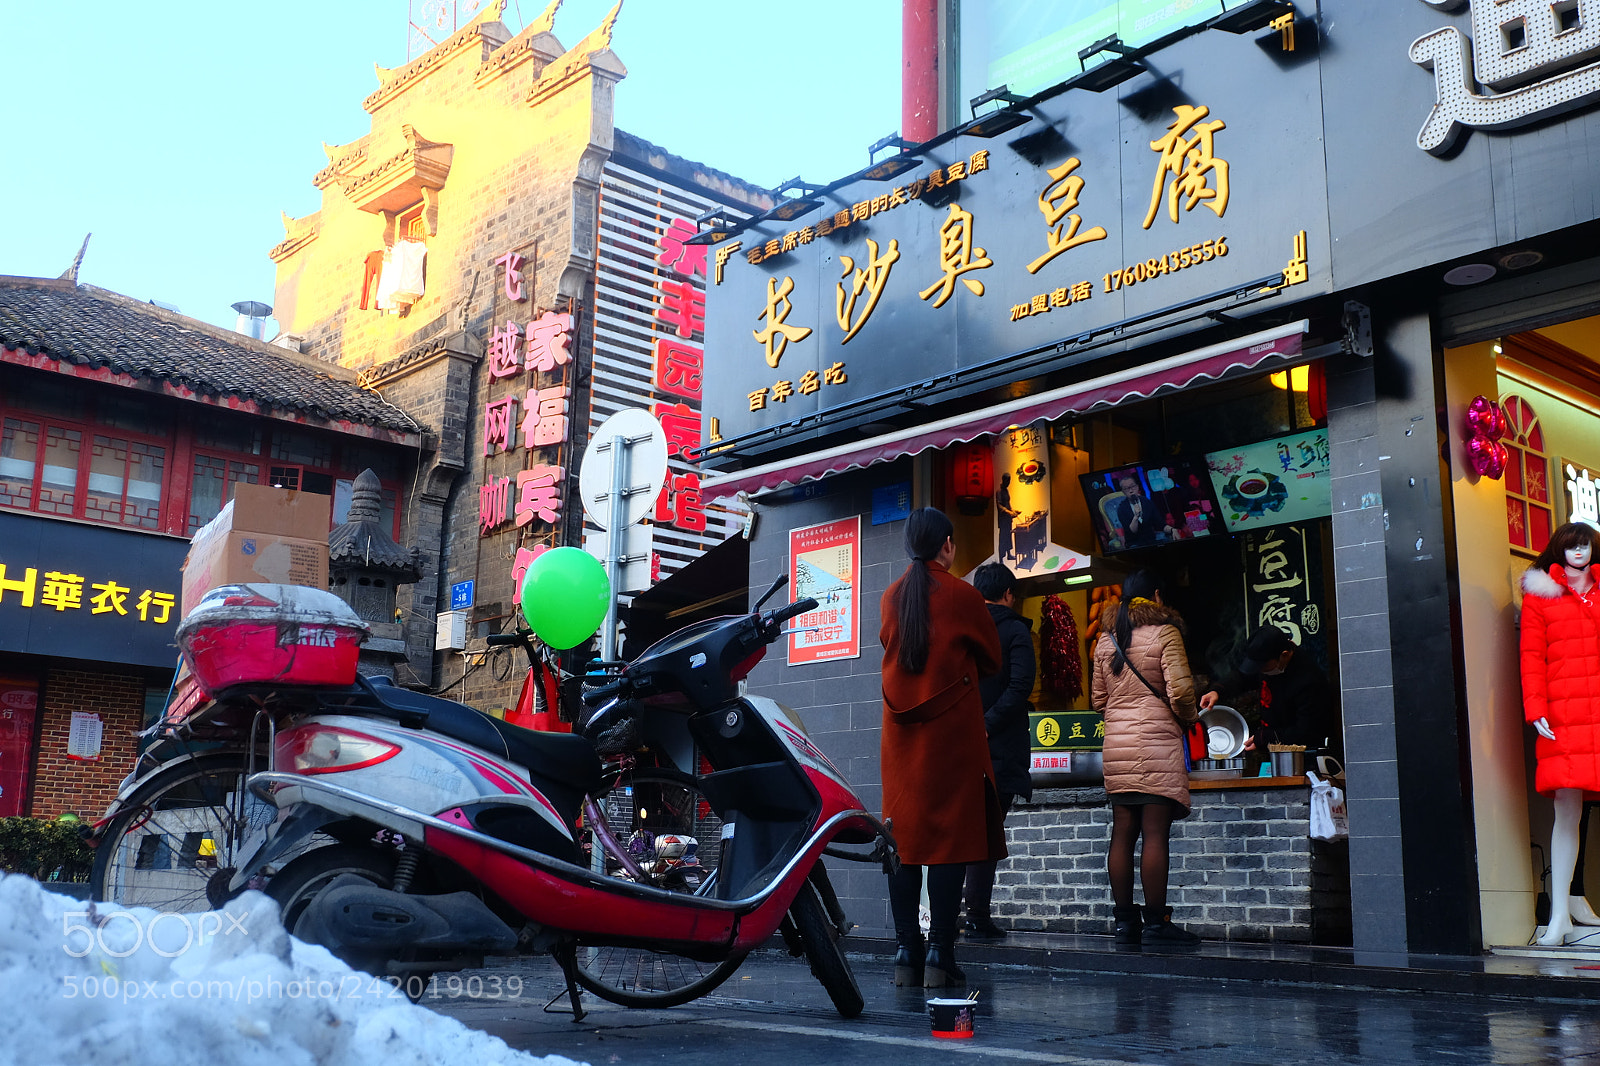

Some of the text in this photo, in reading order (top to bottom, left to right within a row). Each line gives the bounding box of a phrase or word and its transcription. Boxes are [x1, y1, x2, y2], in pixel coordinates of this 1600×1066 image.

[747, 149, 989, 265] 毛主席亲笔题词的长沙臭豆腐
[752, 104, 1231, 368] 长沙臭豆腐
[1010, 236, 1228, 322] 加盟电话 17608435556
[480, 250, 527, 536] 飞越网咖
[747, 362, 847, 412] 百年名吃
[1566, 463, 1600, 532] 迪
[799, 609, 838, 627] 祖国和谐
[1252, 526, 1303, 647] 豆腐
[1033, 757, 1068, 768] 请勿靠近
